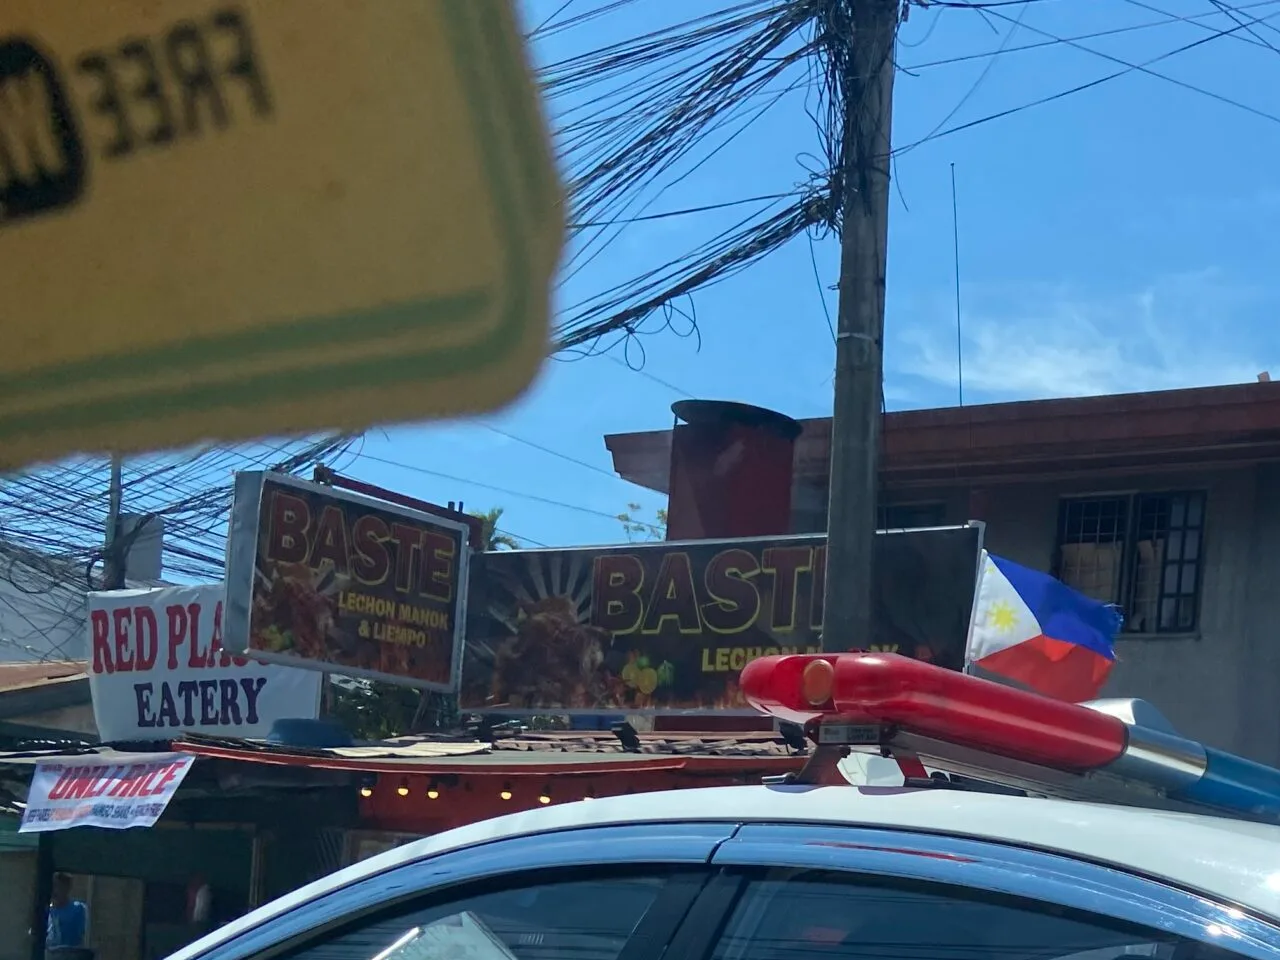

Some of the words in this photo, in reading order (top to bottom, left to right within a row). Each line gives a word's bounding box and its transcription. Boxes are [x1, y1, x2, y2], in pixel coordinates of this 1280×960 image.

[267, 488, 456, 601] BASTE
[338, 590, 396, 618] LECHON
[399, 603, 449, 631] MANOK
[358, 619, 370, 639] &
[373, 622, 427, 648] LIEMPO
[91, 606, 159, 675] RED
[134, 677, 268, 728] EATERY
